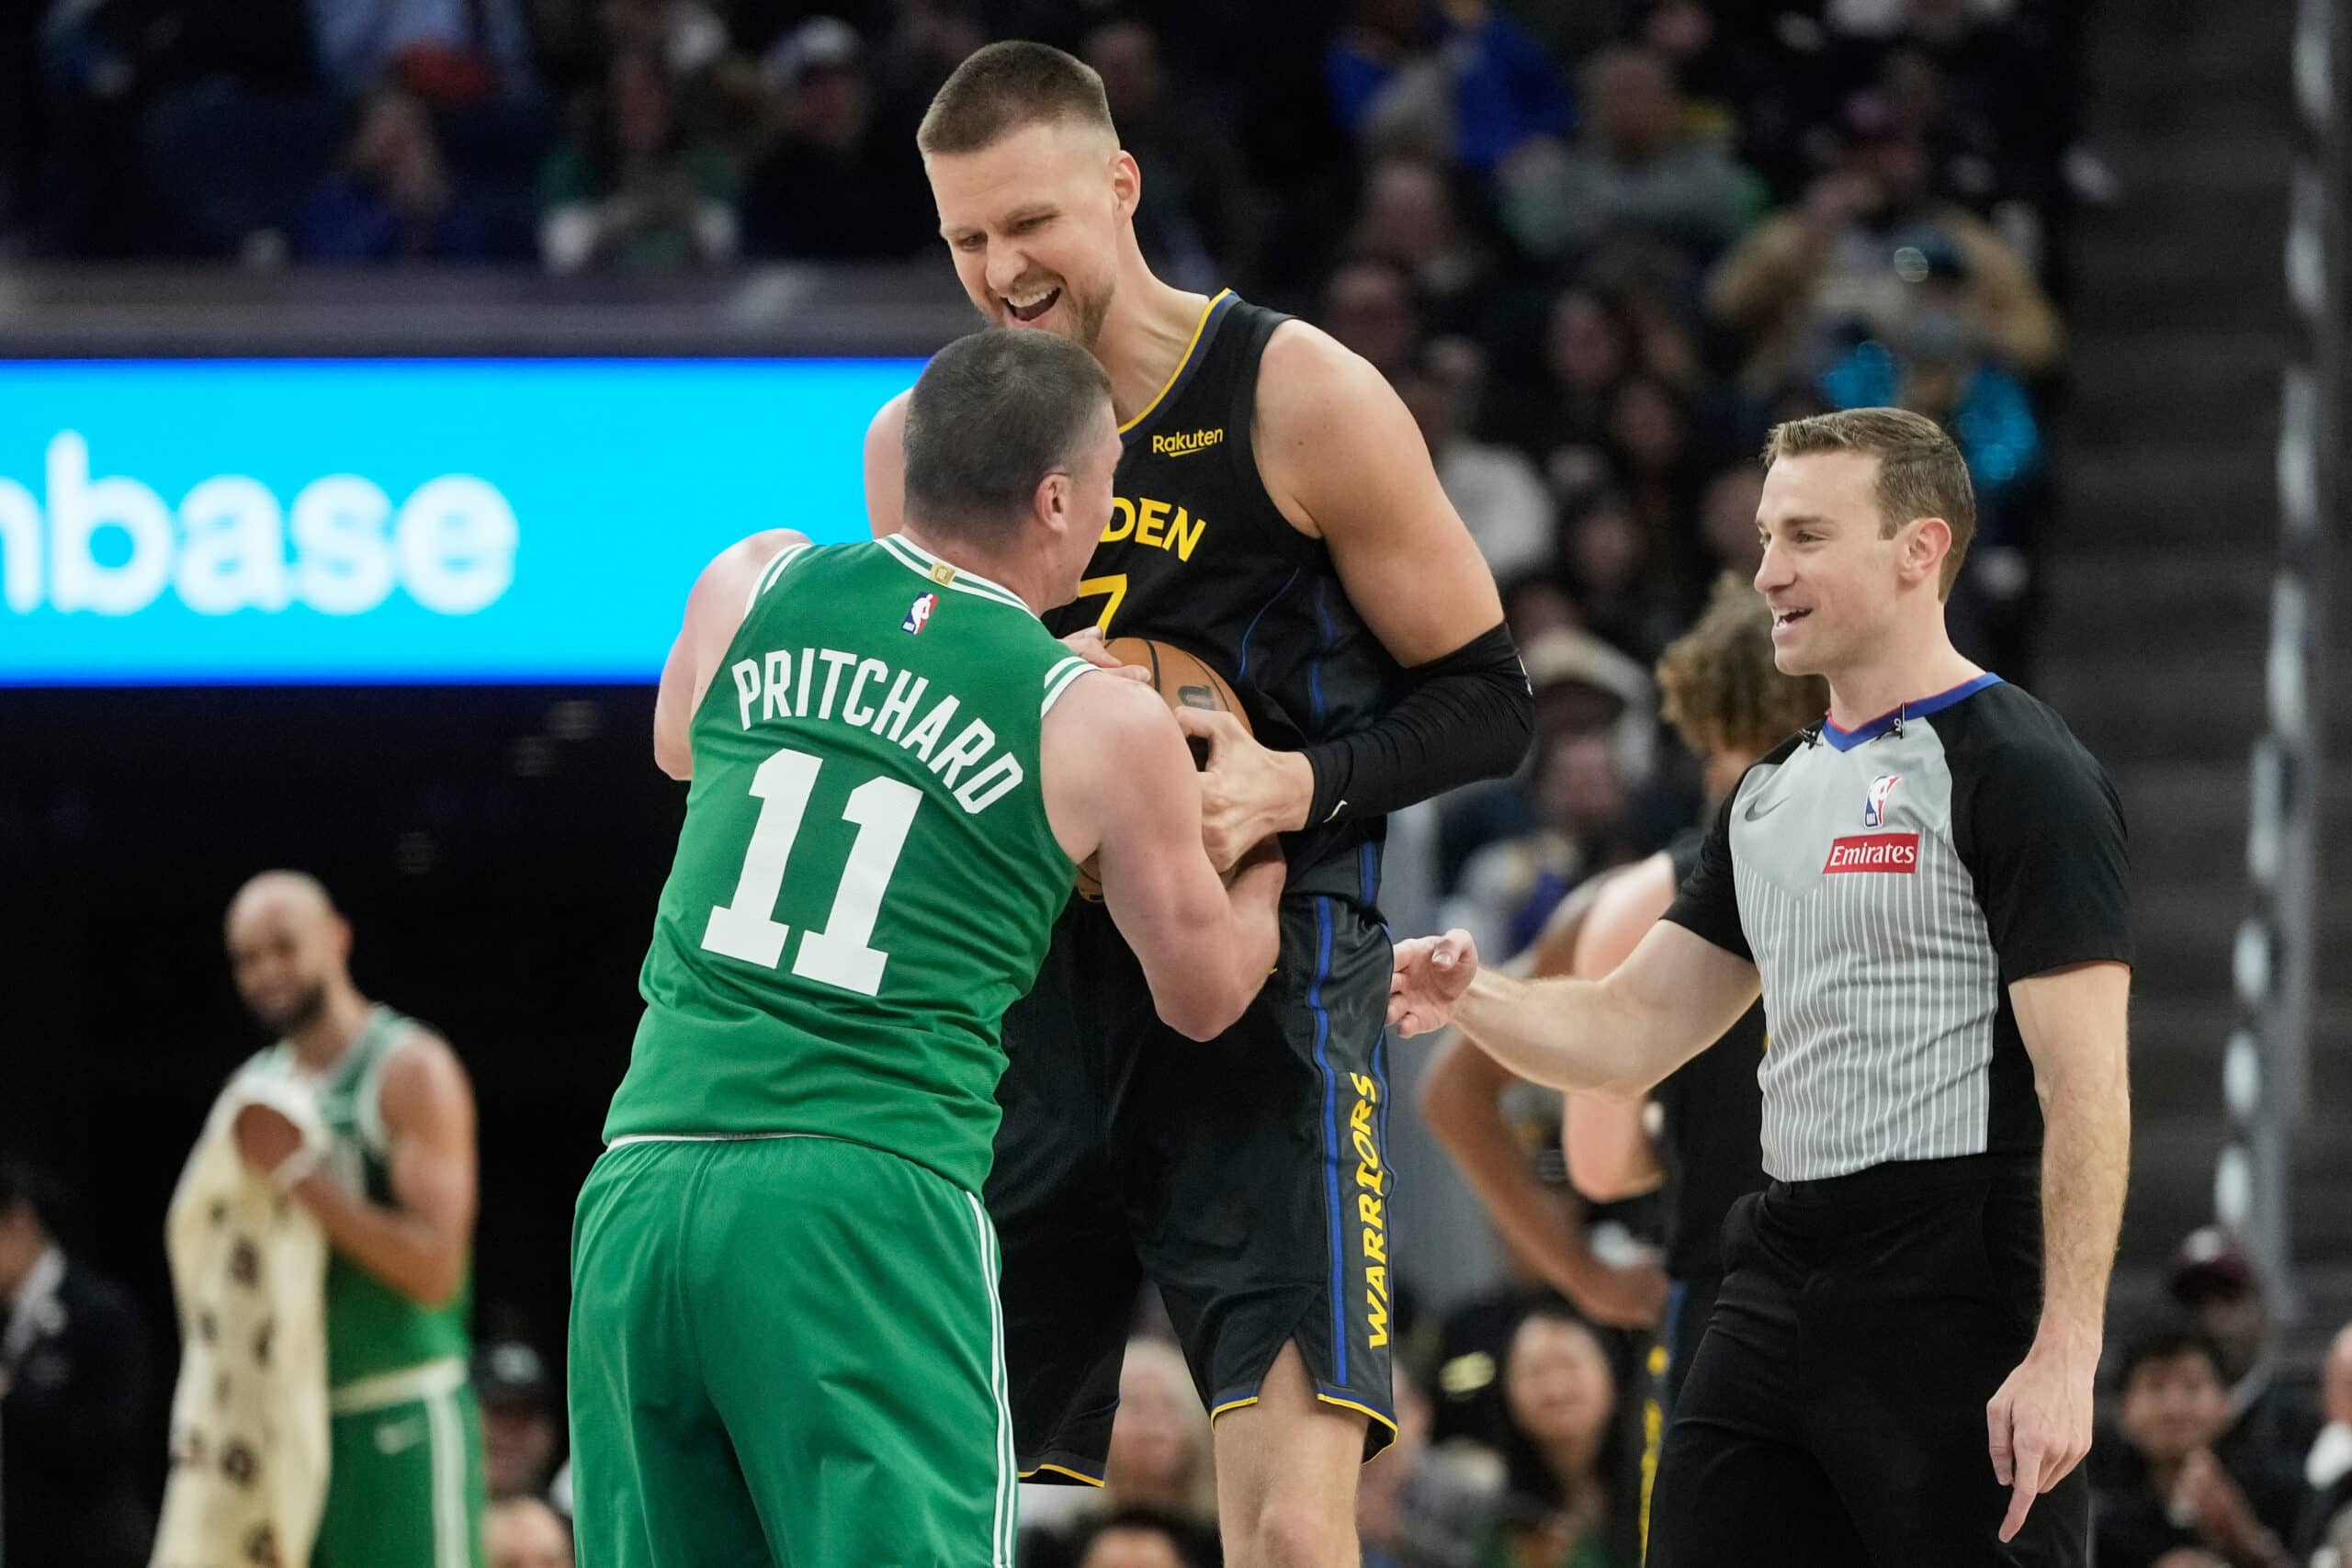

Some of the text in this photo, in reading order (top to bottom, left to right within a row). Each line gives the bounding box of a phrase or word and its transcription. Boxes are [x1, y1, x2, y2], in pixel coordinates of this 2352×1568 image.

[1152, 427, 1224, 457] Rakuten
[1079, 573, 1127, 640] 7
[731, 648, 1023, 814] PRITCHARD
[700, 748, 923, 997] 11
[1829, 842, 1915, 866] Emirates
[1350, 1072, 1385, 1348] WARRIORS
